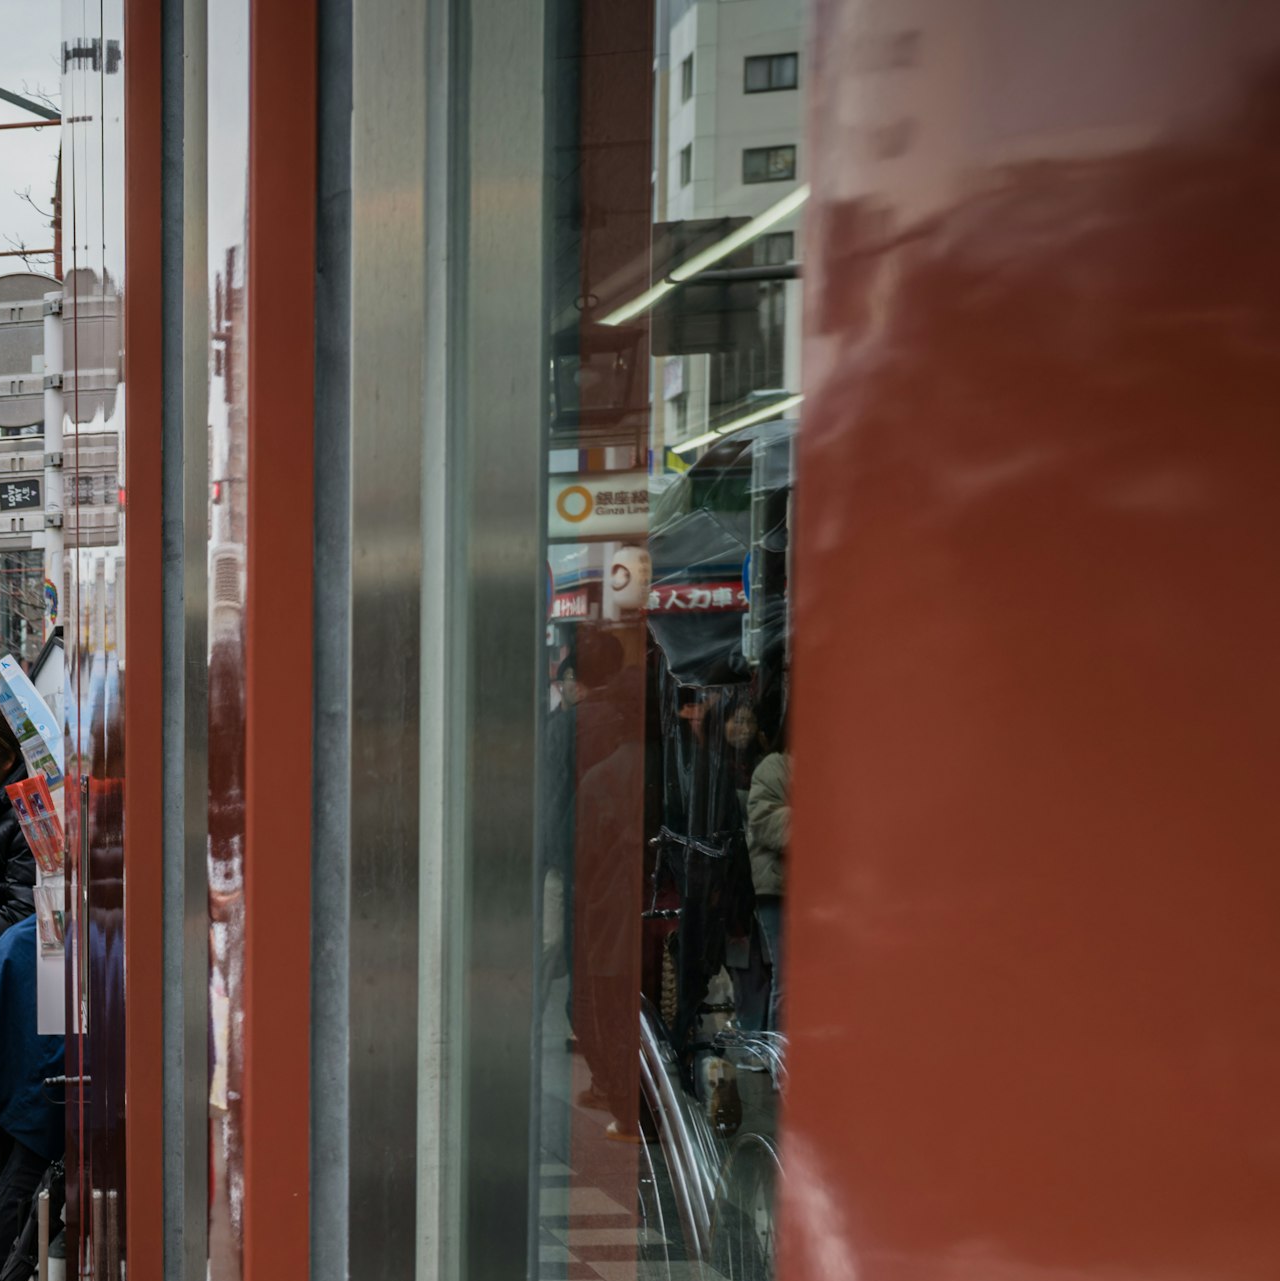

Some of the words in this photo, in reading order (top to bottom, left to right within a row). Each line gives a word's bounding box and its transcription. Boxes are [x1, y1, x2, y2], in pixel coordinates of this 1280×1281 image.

[7, 484, 16, 507] LOVE
[15, 488, 23, 502] MY
[595, 505, 625, 516] Ginza
